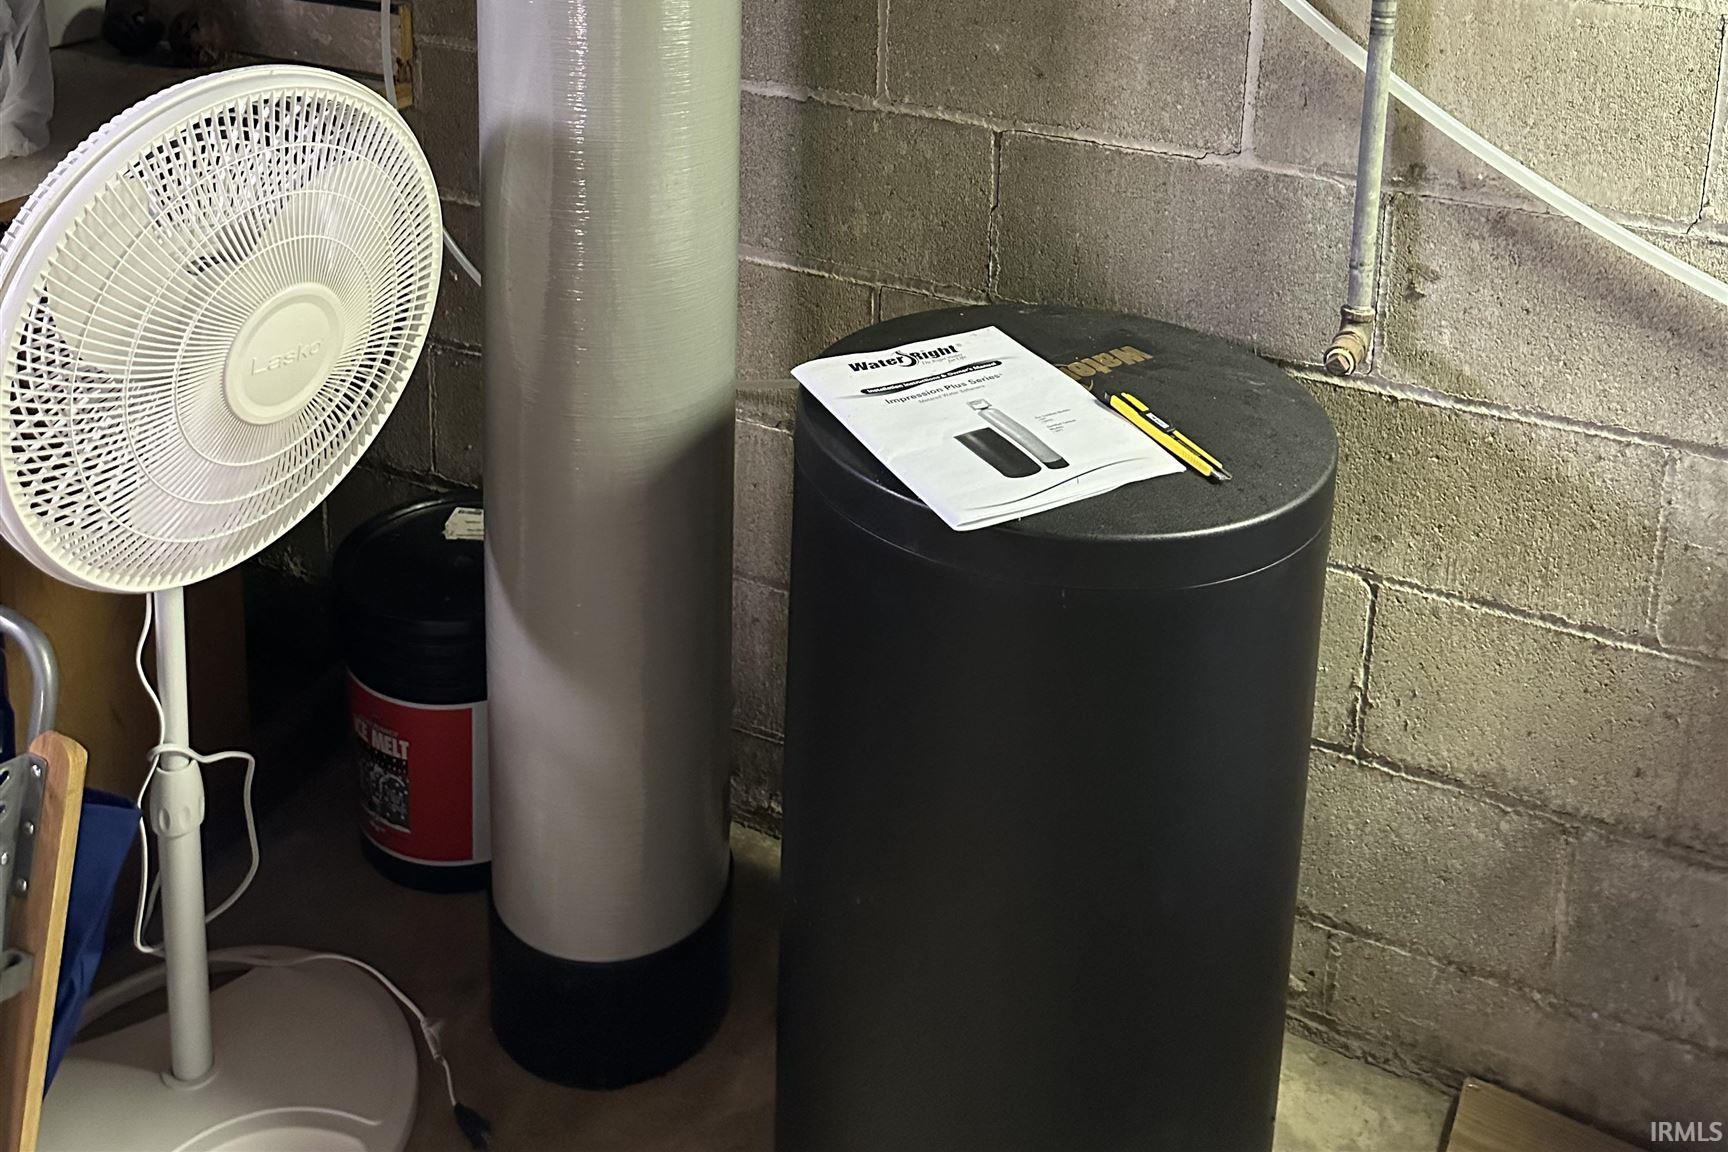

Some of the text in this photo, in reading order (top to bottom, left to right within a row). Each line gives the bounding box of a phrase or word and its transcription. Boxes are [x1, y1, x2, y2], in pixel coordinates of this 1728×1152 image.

[251, 342, 321, 376] Lasko
[885, 388, 944, 405] Impression
[943, 382, 967, 391] Plus
[371, 728, 410, 760] MELT
